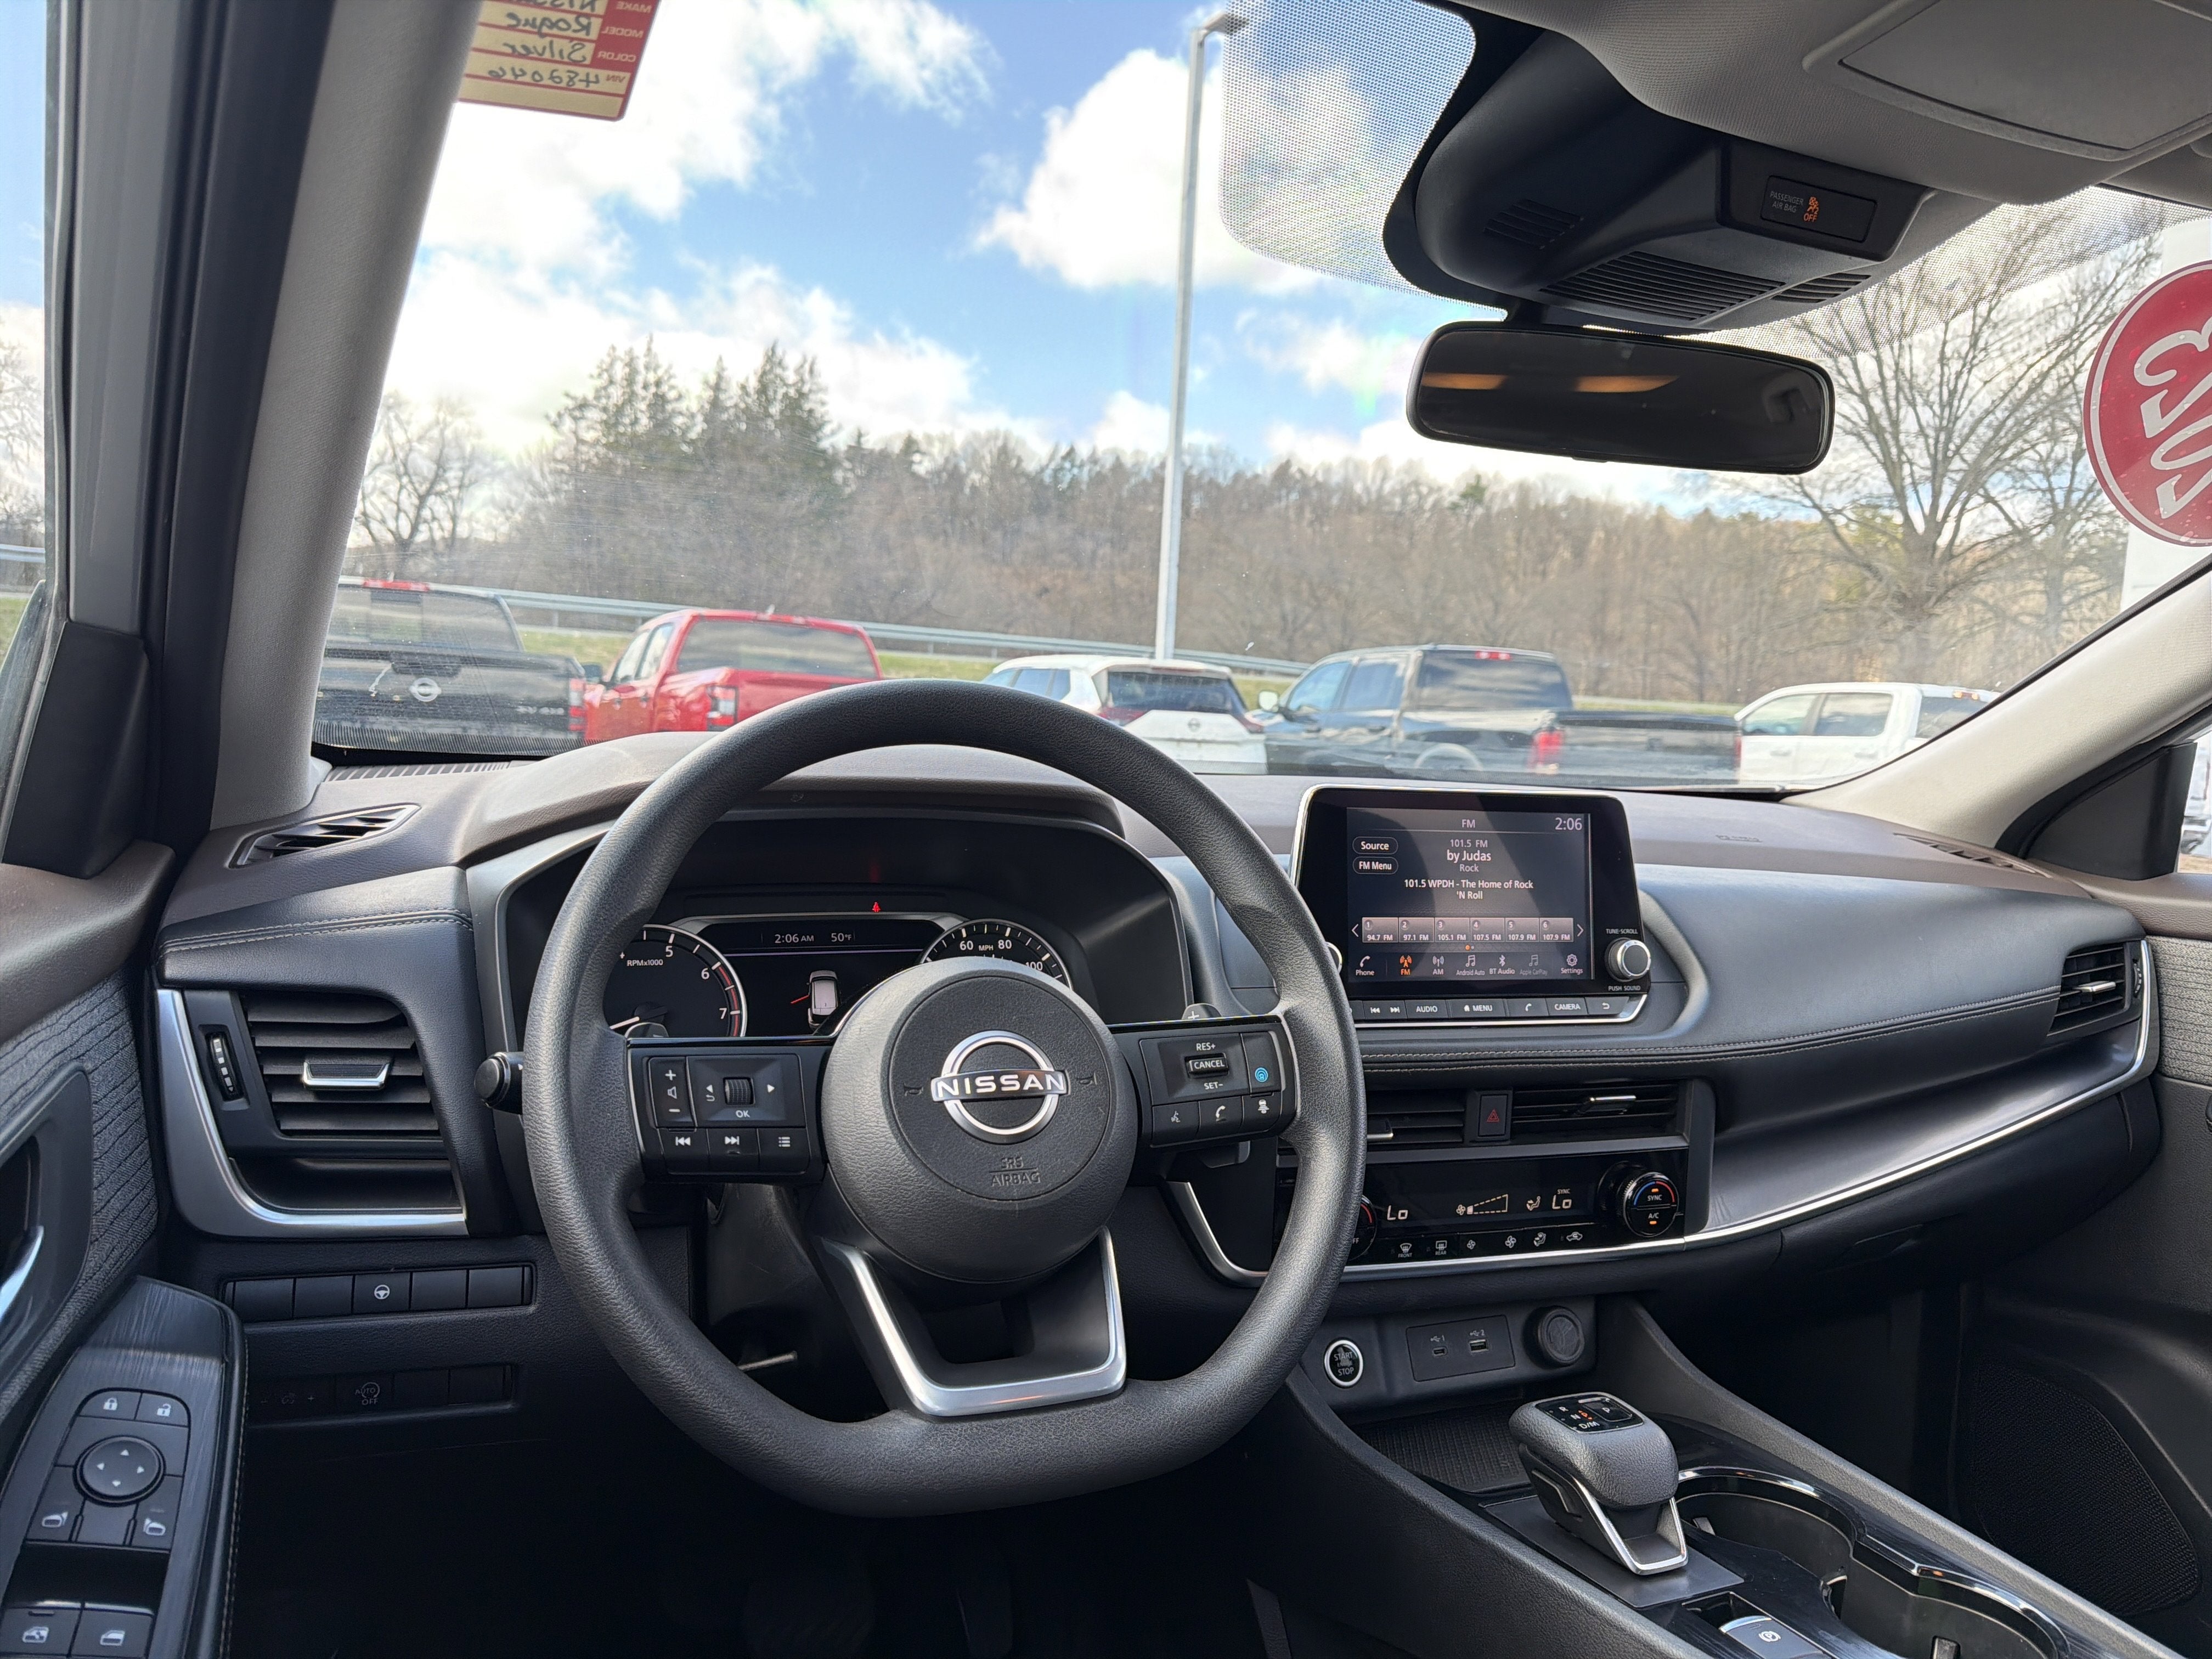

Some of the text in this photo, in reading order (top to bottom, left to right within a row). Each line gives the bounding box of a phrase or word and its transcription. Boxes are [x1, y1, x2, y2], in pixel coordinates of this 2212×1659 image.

[1770, 190, 1804, 206] PASSENGER
[1772, 201, 1797, 213] AIR BAG
[1803, 213, 1818, 222] OFF
[1462, 819, 1476, 828] FM
[1555, 817, 1582, 831] 2:06
[1361, 841, 1389, 850] Source
[1450, 839, 1488, 848] 101.5 FM
[1447, 849, 1492, 863] by Judas
[1359, 861, 1392, 870] FM Menu
[1459, 864, 1479, 872] Rock
[1404, 879, 1426, 888] 101.5
[1427, 879, 1454, 888] WPDH
[1460, 879, 1476, 888] The
[1479, 880, 1502, 889] Home
[1504, 880, 1513, 889] of
[1514, 880, 1533, 889] Rock
[1457, 891, 1483, 899] 'N Roll
[774, 934, 799, 944] 2:06
[998, 939, 1012, 950] 80
[665, 945, 674, 957] 5
[960, 940, 974, 951] 60
[701, 968, 710, 980] 6
[719, 1007, 727, 1019] 7
[1195, 1042, 1216, 1051] RES+
[1193, 1059, 1225, 1070] CANCEL
[937, 1073, 1065, 1098] NISSAN
[736, 1110, 751, 1118] OK
[1001, 1156, 1024, 1169] SRS
[991, 1172, 1041, 1187] AIRBAG
[1552, 1194, 1572, 1210] Lo
[1387, 1205, 1408, 1221] Lo
[1334, 1352, 1353, 1361] START
[1338, 1367, 1355, 1376] STOP
